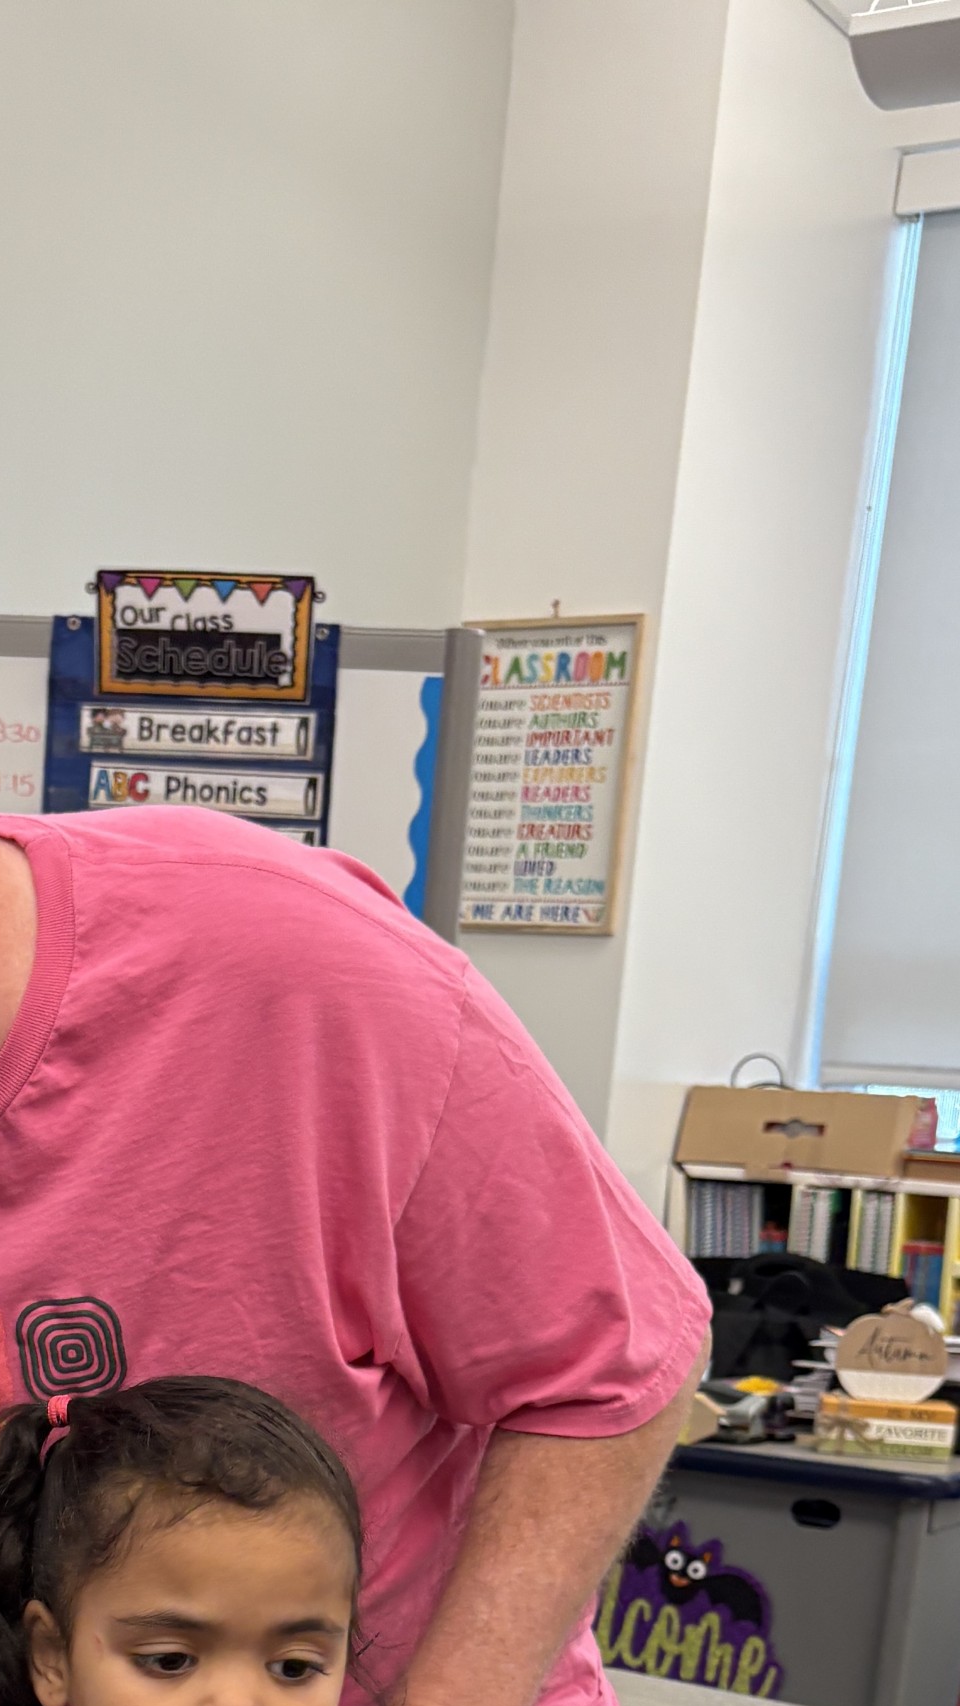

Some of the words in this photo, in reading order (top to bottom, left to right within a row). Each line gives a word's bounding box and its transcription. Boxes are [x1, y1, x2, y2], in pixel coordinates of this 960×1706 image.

[120, 604, 166, 627] Our
[116, 636, 289, 678] Schedule
[137, 716, 280, 746] Breakfast
[525, 728, 615, 747] IMPORTANT
[524, 748, 592, 766] LEADERS
[93, 769, 150, 803] ABC
[164, 774, 268, 805] Phonics
[521, 785, 592, 803] READERS
[501, 904, 534, 921] ARE
[540, 905, 580, 923] HERE
